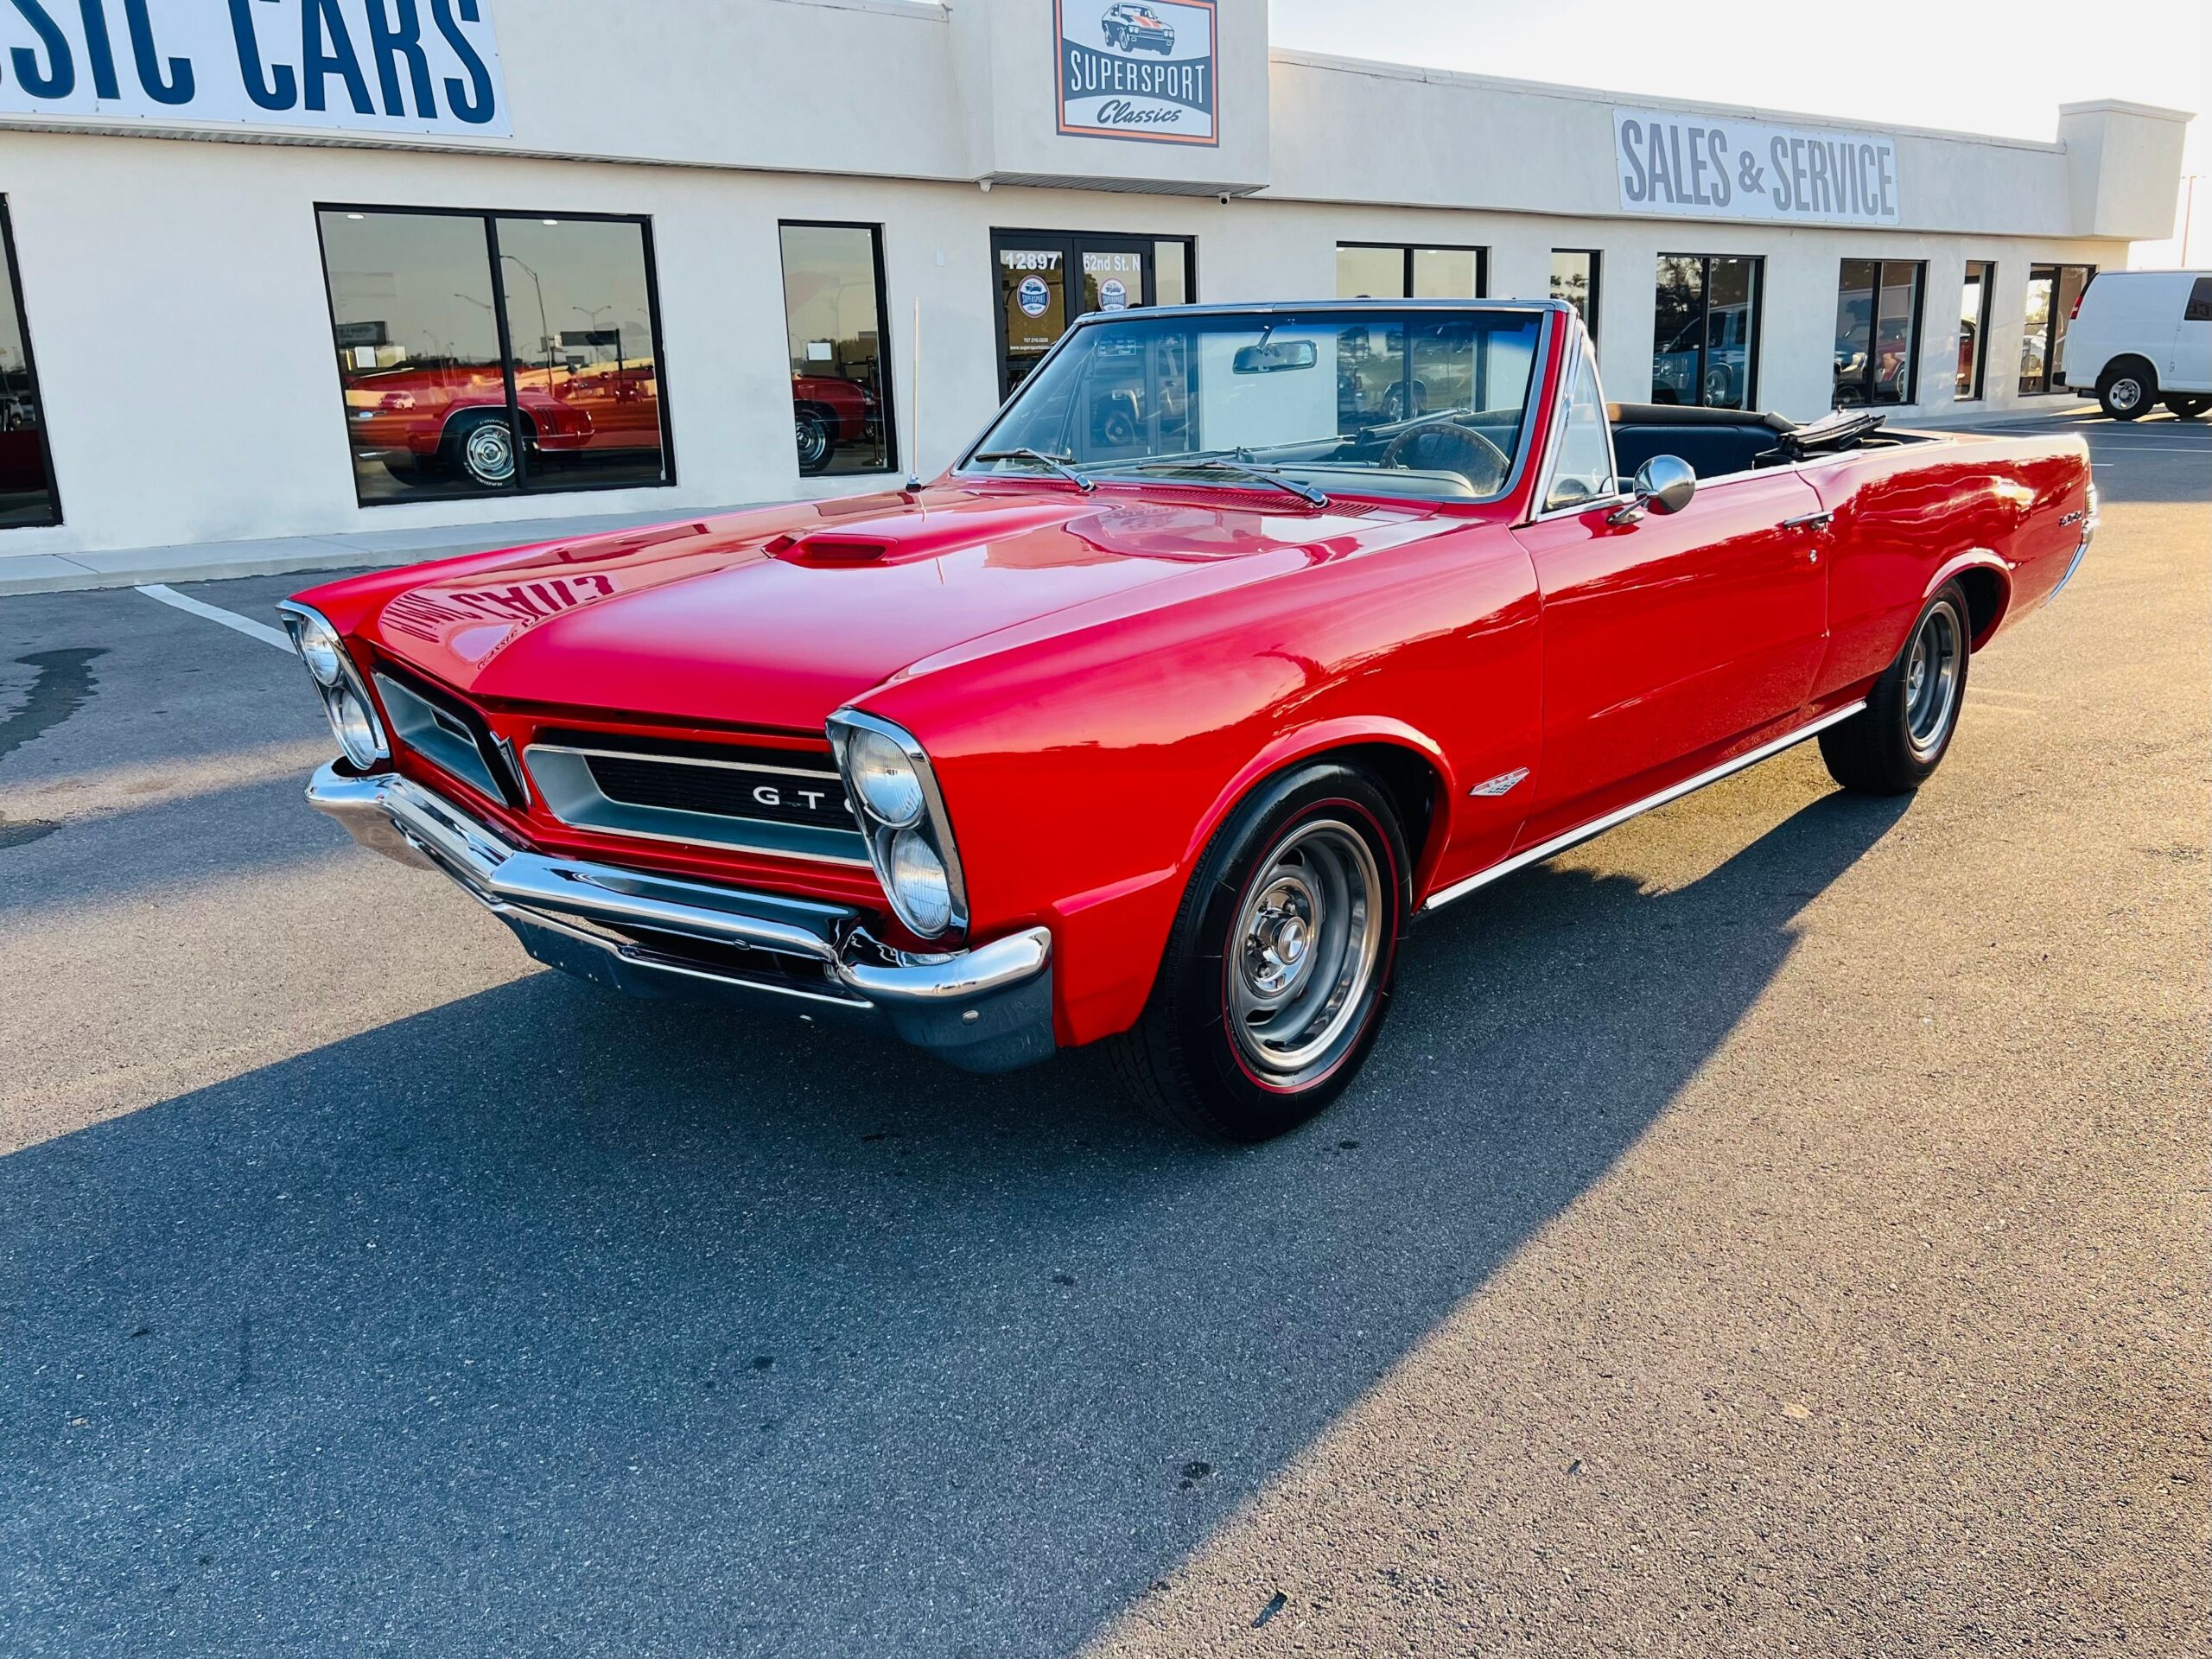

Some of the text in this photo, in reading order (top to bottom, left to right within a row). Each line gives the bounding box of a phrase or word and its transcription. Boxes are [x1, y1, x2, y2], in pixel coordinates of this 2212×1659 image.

[0, 0, 496, 124] SIC CARS
[1071, 50, 1205, 103] SUPERSPORT
[1096, 99, 1182, 124] Classics
[1621, 119, 1895, 216] SALES & SERVICE
[1005, 252, 1058, 270] 12897
[1084, 255, 1141, 271] 62nd St. N
[753, 785, 854, 814] GT
